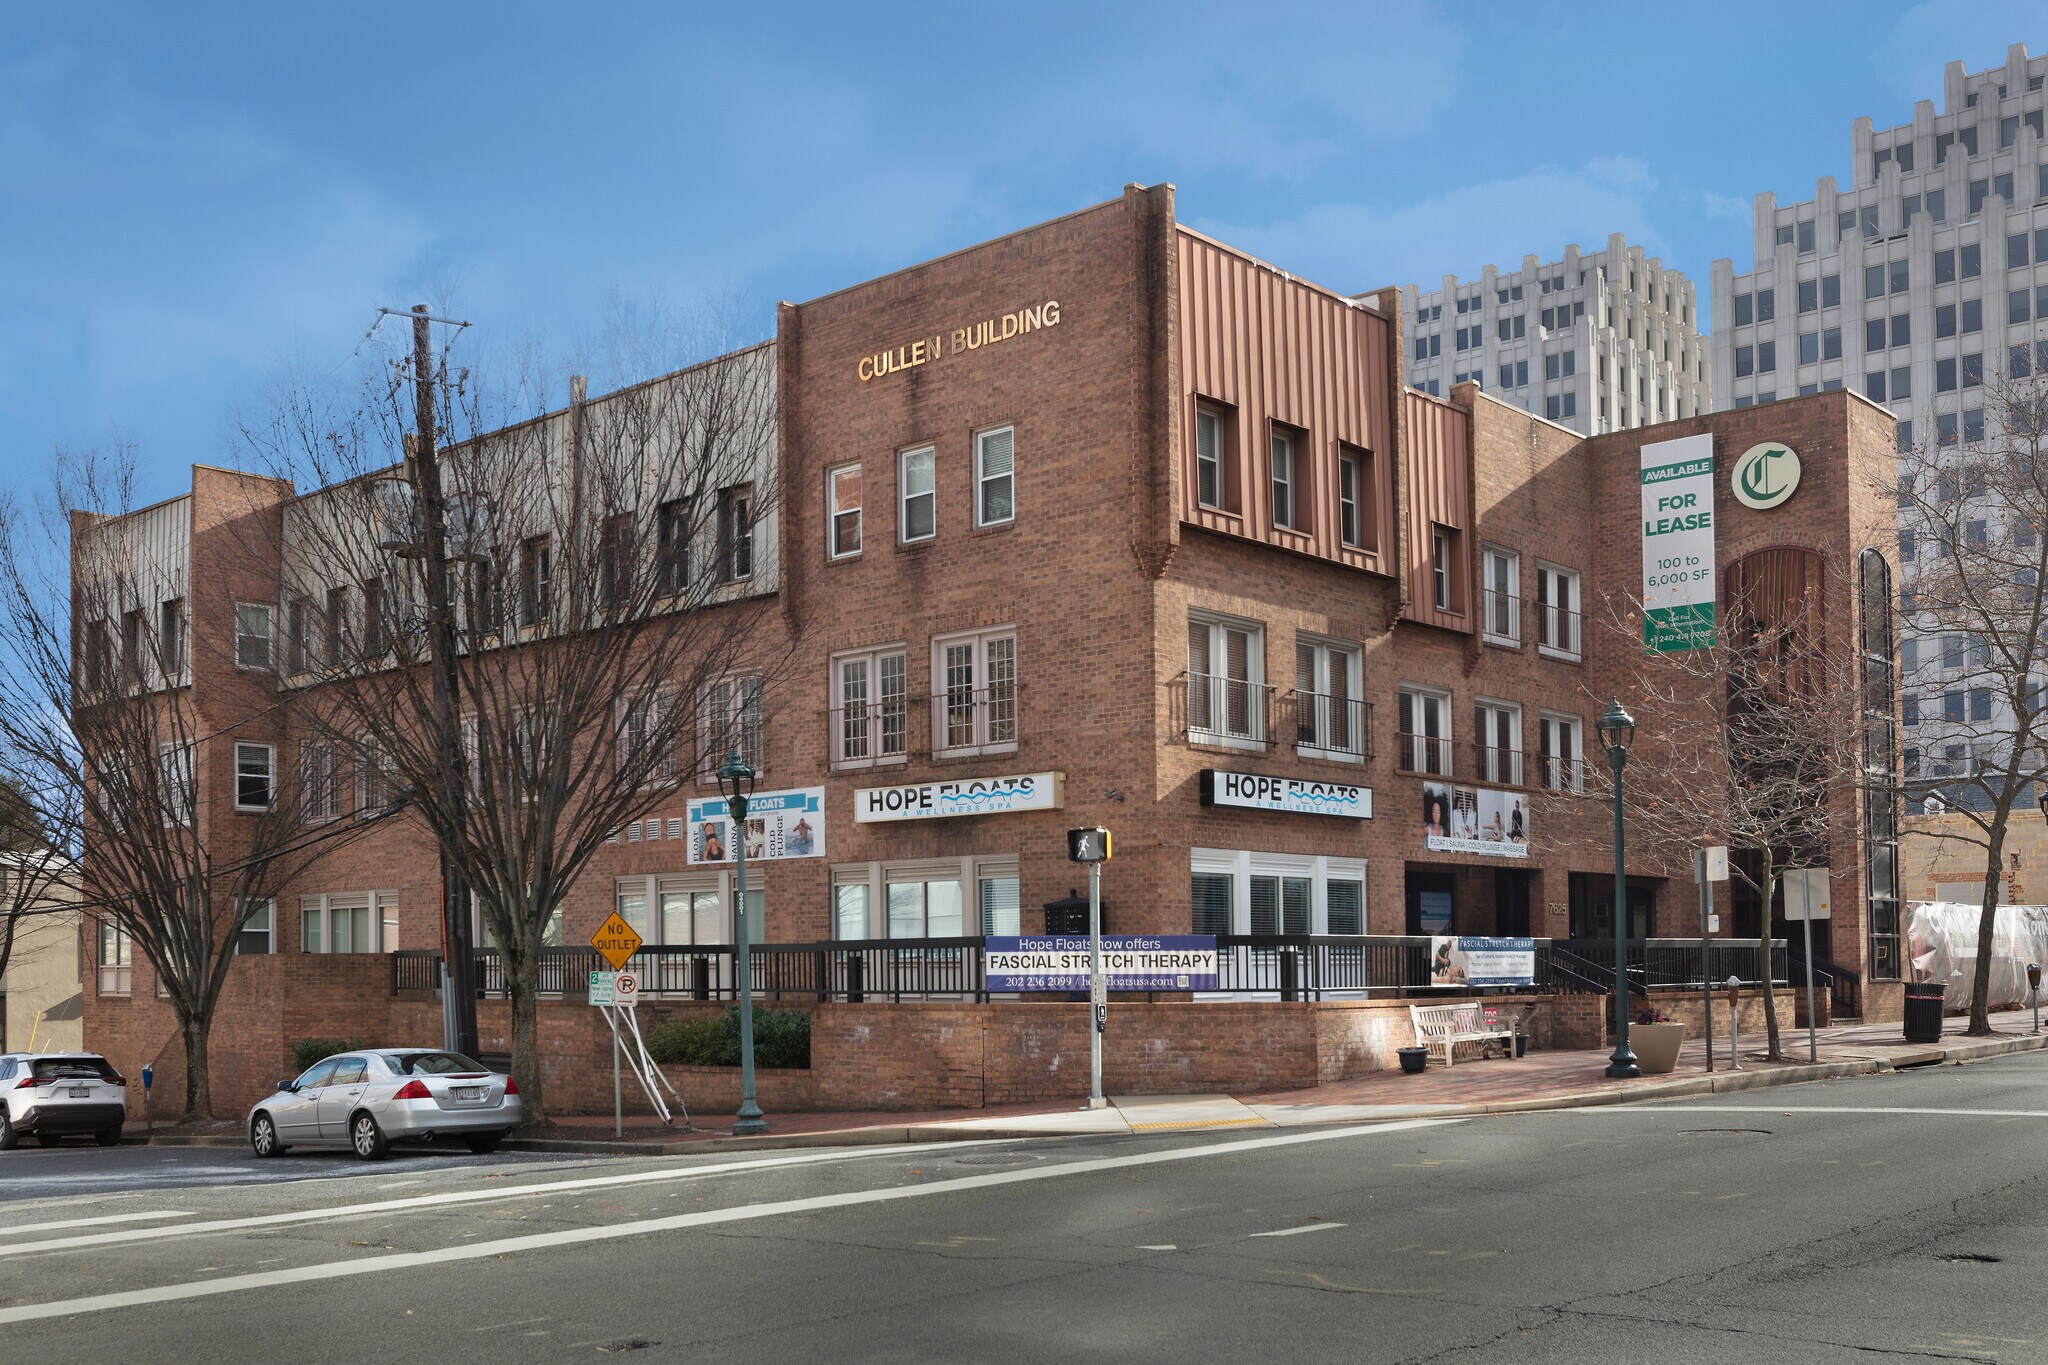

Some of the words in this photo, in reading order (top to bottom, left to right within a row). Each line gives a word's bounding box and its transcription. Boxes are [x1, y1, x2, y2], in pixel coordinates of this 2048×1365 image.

[858, 336, 941, 381] CULLEN
[951, 300, 1061, 355] BUILDING
[1644, 461, 1710, 482] AVAILABLE
[1741, 449, 1789, 501] C
[1658, 493, 1697, 512] FOR
[1645, 512, 1711, 536] LEASE
[1657, 557, 1681, 569] 100
[1686, 556, 1699, 566] to
[1648, 571, 1689, 587] 6,000
[1692, 569, 1710, 581] SF
[1660, 634, 1674, 643] 240
[869, 786, 932, 812] HOPE
[940, 777, 1035, 806] FLOATS
[1226, 774, 1282, 801] HOPE
[1288, 781, 1360, 809] FLOATS
[750, 797, 785, 811] FLOATS
[902, 809, 908, 817] A
[916, 805, 981, 816] WELLNESS
[989, 802, 1012, 810] SPA
[1268, 801, 1320, 813] WELLNESS
[1326, 807, 1343, 815] SPA
[1430, 838, 1446, 847] FLOAT
[1449, 840, 1465, 848] SAUNA
[1468, 842, 1481, 850] COLD
[1482, 843, 1500, 852] PLUNGE
[1503, 845, 1525, 854] MASSAGE
[1549, 902, 1567, 916] 7625
[607, 924, 624, 935] NO
[597, 939, 637, 950] OUTLET
[1019, 938, 1052, 952] Hope
[1056, 938, 1091, 950] Floats
[1099, 940, 1123, 950] now
[1125, 937, 1161, 949] offers
[1460, 939, 1484, 948] FASCIAL
[1484, 940, 1510, 948] STRETCH
[990, 955, 1057, 969] FASCIAL
[1061, 954, 1133, 968] STRTCH
[1138, 954, 1212, 968] THERAPY
[591, 973, 598, 983] 2
[1006, 977, 1024, 987] 202
[1026, 977, 1045, 987] 236
[1047, 976, 1072, 986] 2099
[1082, 975, 1174, 986] hfloatsusa.com
